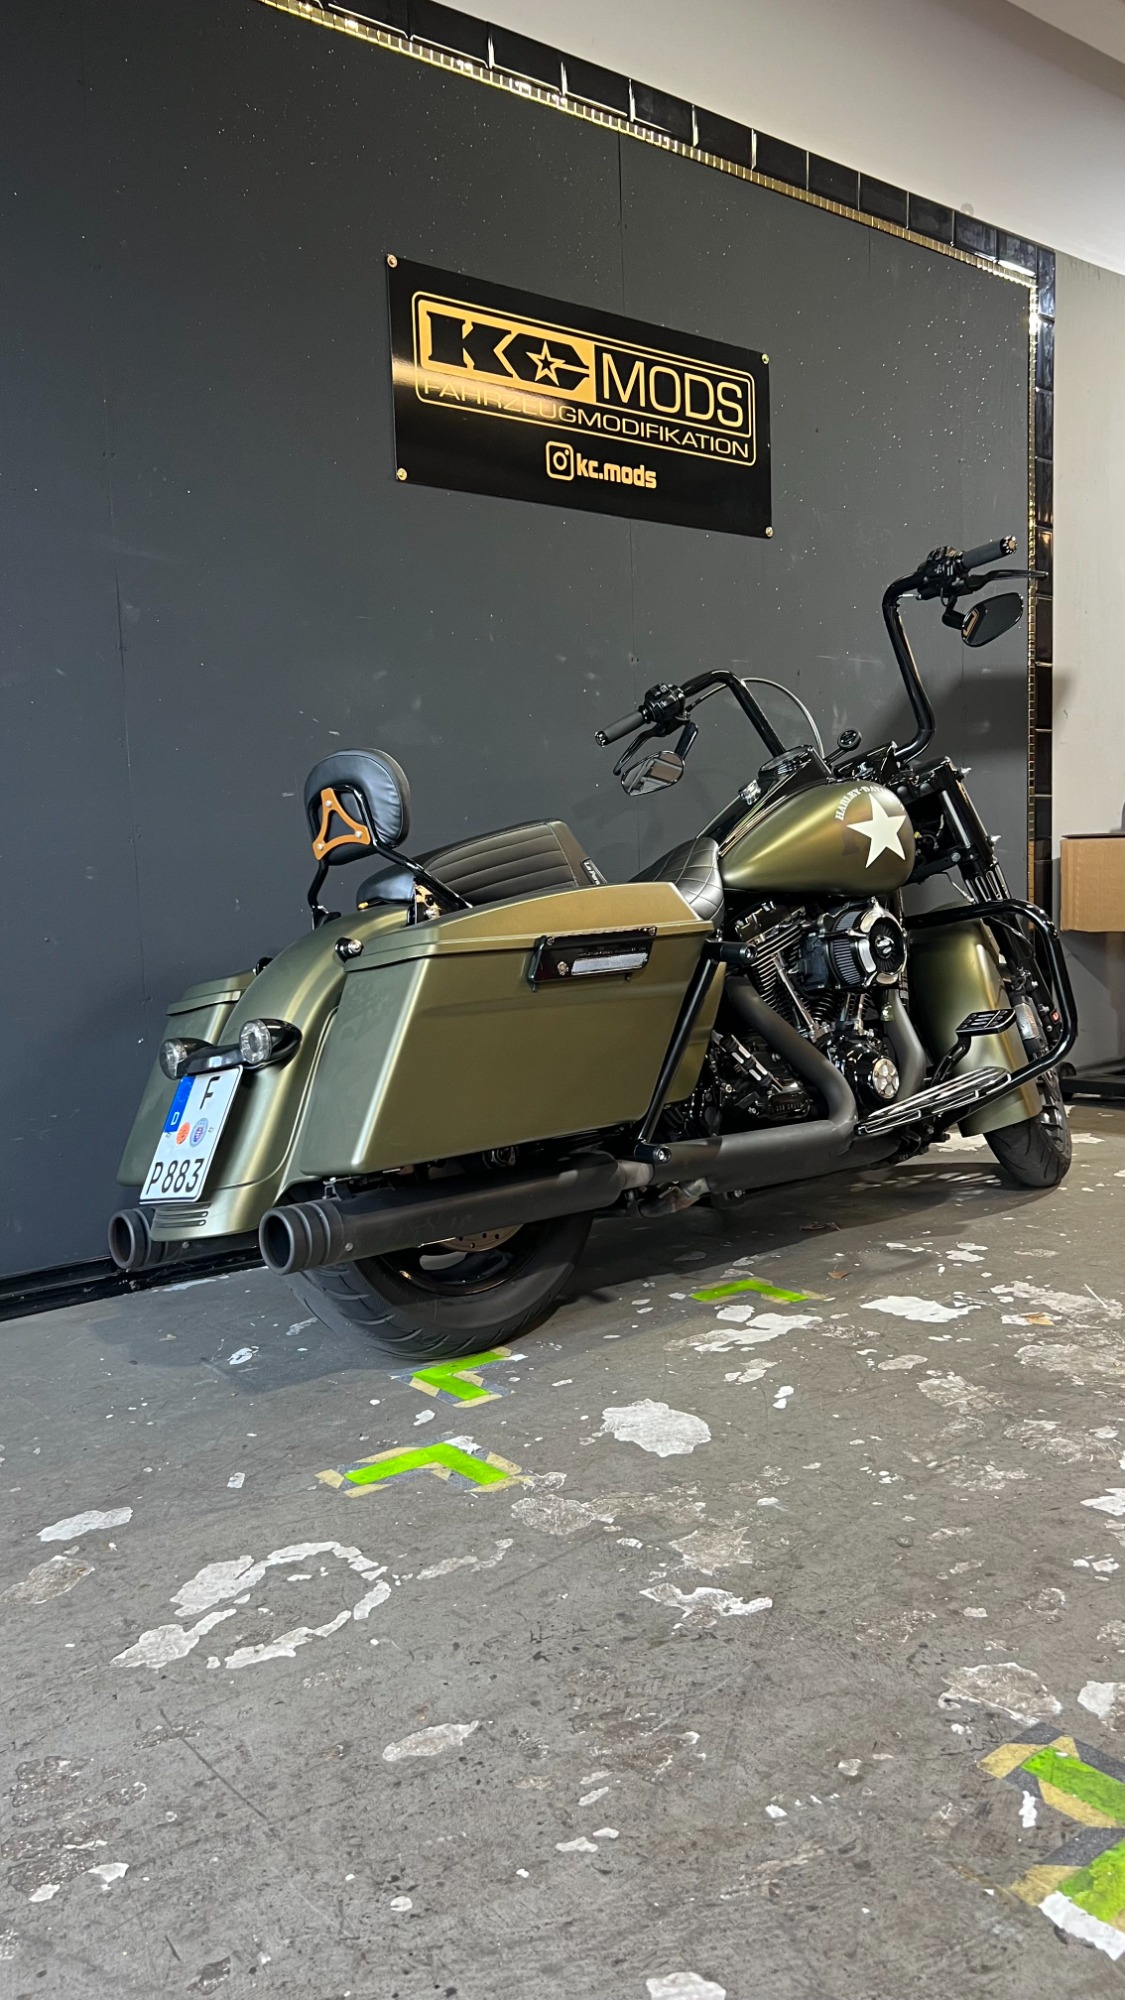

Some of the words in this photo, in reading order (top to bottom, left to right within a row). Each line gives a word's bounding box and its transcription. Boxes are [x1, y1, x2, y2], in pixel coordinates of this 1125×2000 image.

[602, 353, 744, 428] MODS
[424, 378, 749, 459] FAHRZEUGMODIFIKATION
[576, 452, 657, 489] kc.mods
[199, 1076, 221, 1110] F
[170, 1111, 181, 1126] D
